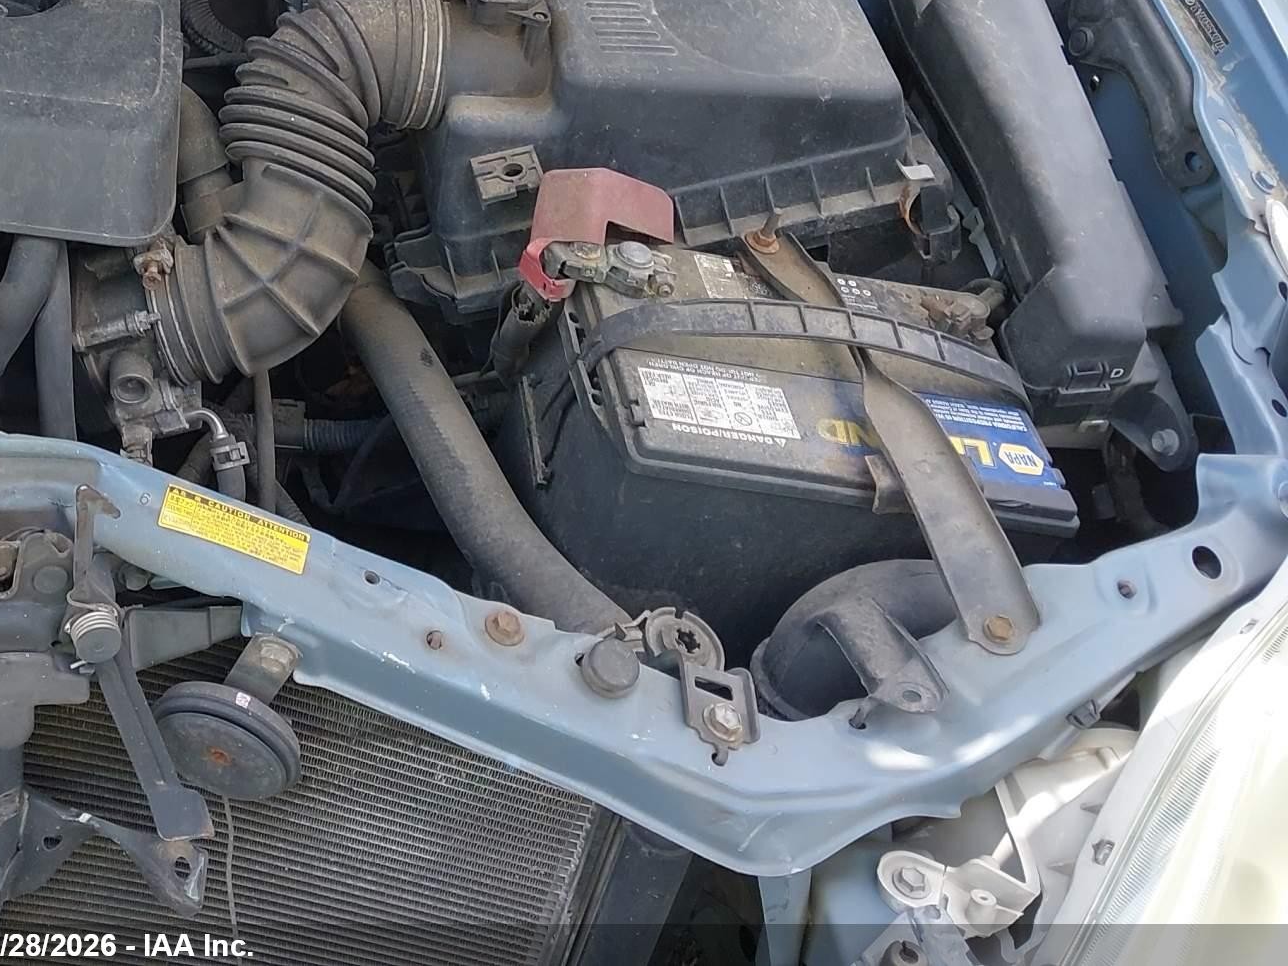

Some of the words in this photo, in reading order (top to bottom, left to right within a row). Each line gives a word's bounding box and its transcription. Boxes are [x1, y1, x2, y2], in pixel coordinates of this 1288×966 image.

[1110, 368, 1124, 378] D
[672, 422, 774, 445] DANGER/POISON
[1004, 451, 1039, 468] NAPA
[208, 499, 251, 524] CAUTION
[257, 517, 306, 541] ATTENTION
